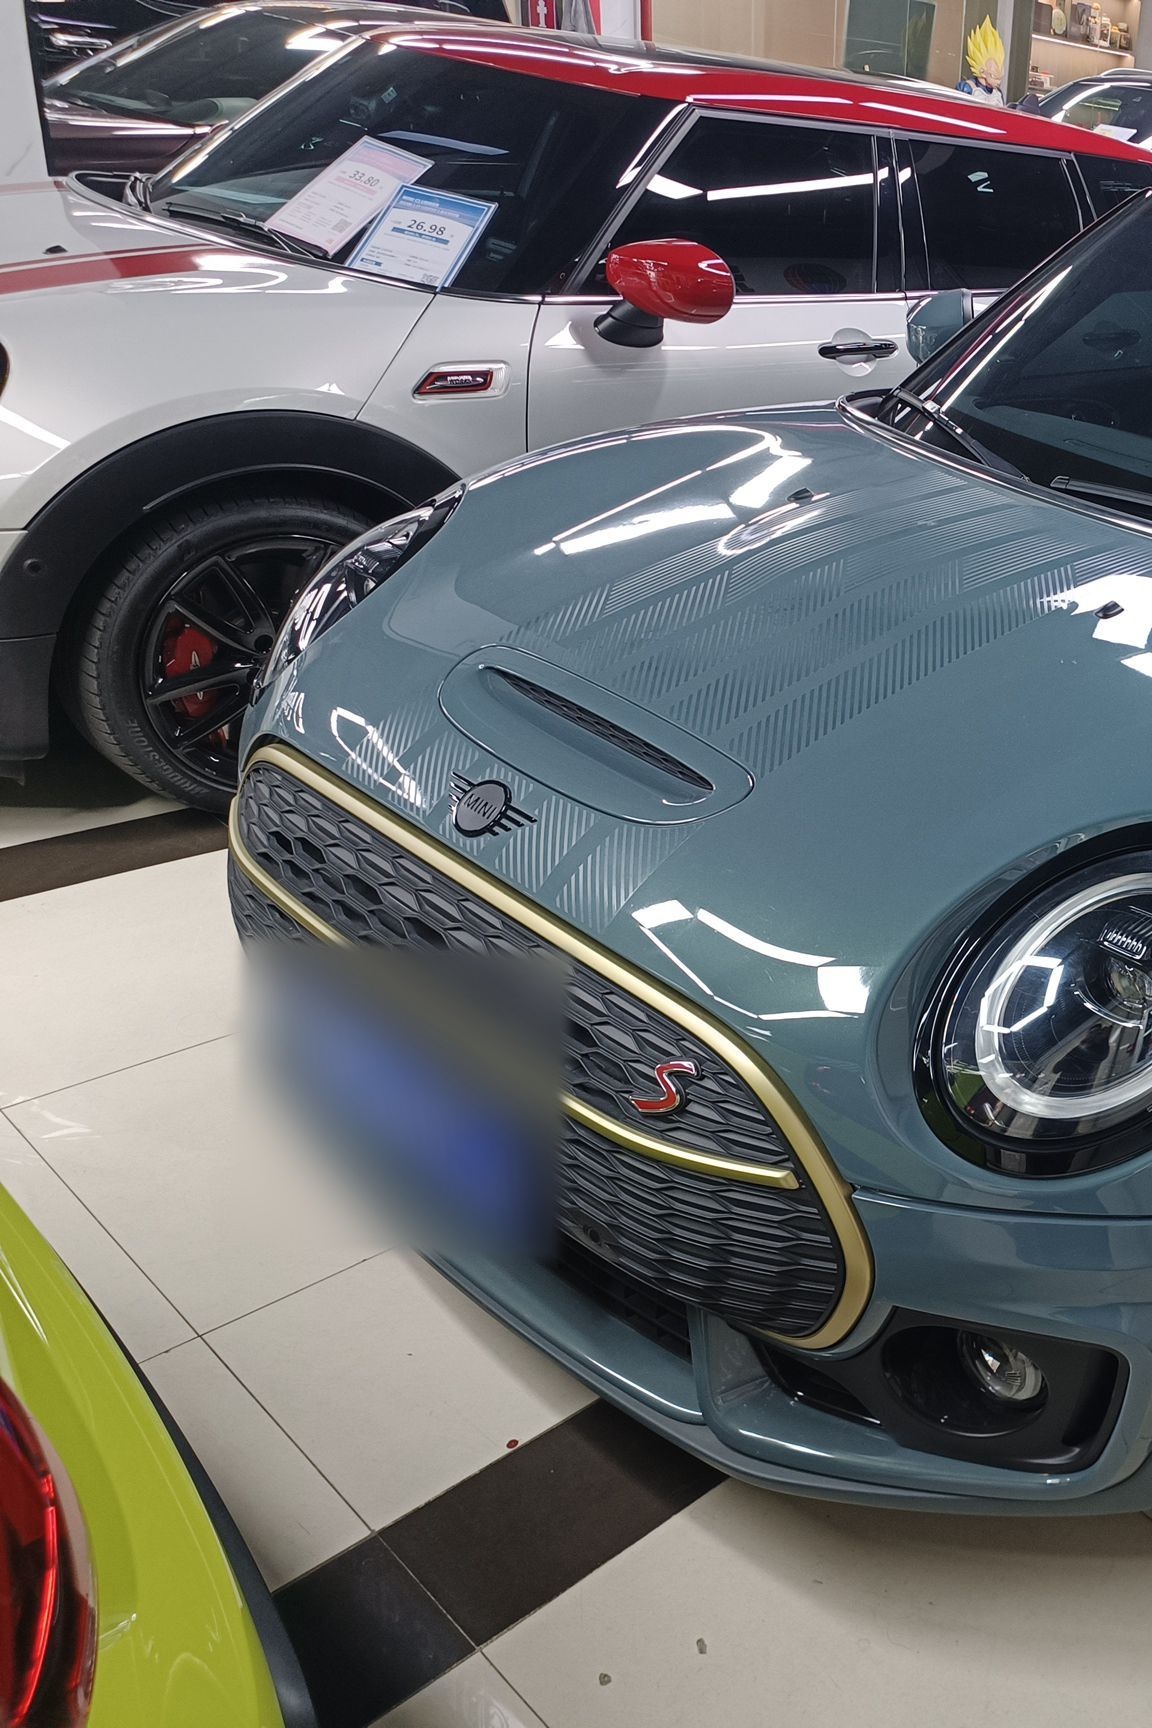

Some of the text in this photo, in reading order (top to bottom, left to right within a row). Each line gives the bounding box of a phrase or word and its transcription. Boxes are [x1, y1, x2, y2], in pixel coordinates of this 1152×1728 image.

[348, 170, 380, 187] 33.80
[407, 219, 446, 236] 26.98
[463, 793, 498, 820] MINI
[628, 1060, 696, 1113] S
